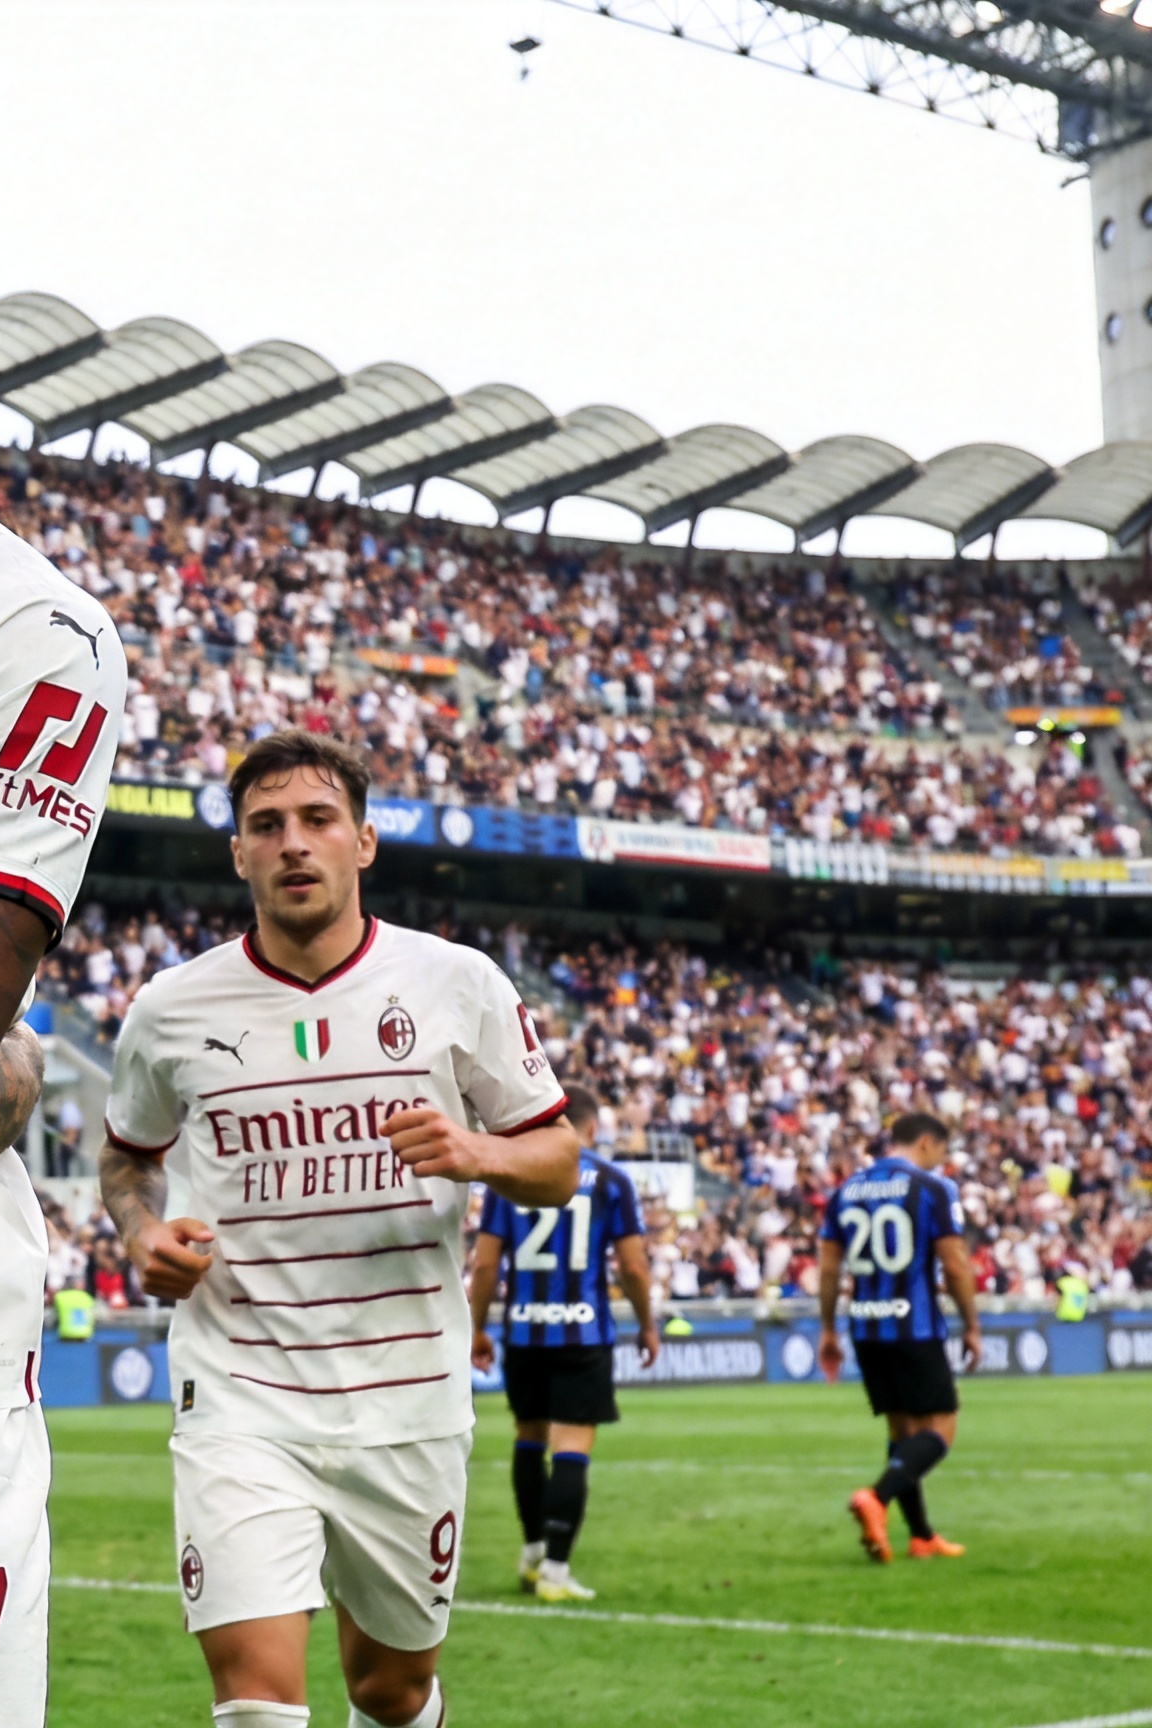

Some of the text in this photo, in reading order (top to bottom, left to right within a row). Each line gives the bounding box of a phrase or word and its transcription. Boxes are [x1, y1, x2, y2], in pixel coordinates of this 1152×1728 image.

[244, 1151, 404, 1203] FLY BETTER
[515, 1195, 592, 1271] 21
[839, 1204, 914, 1274] 20
[430, 1510, 456, 1583] 9
